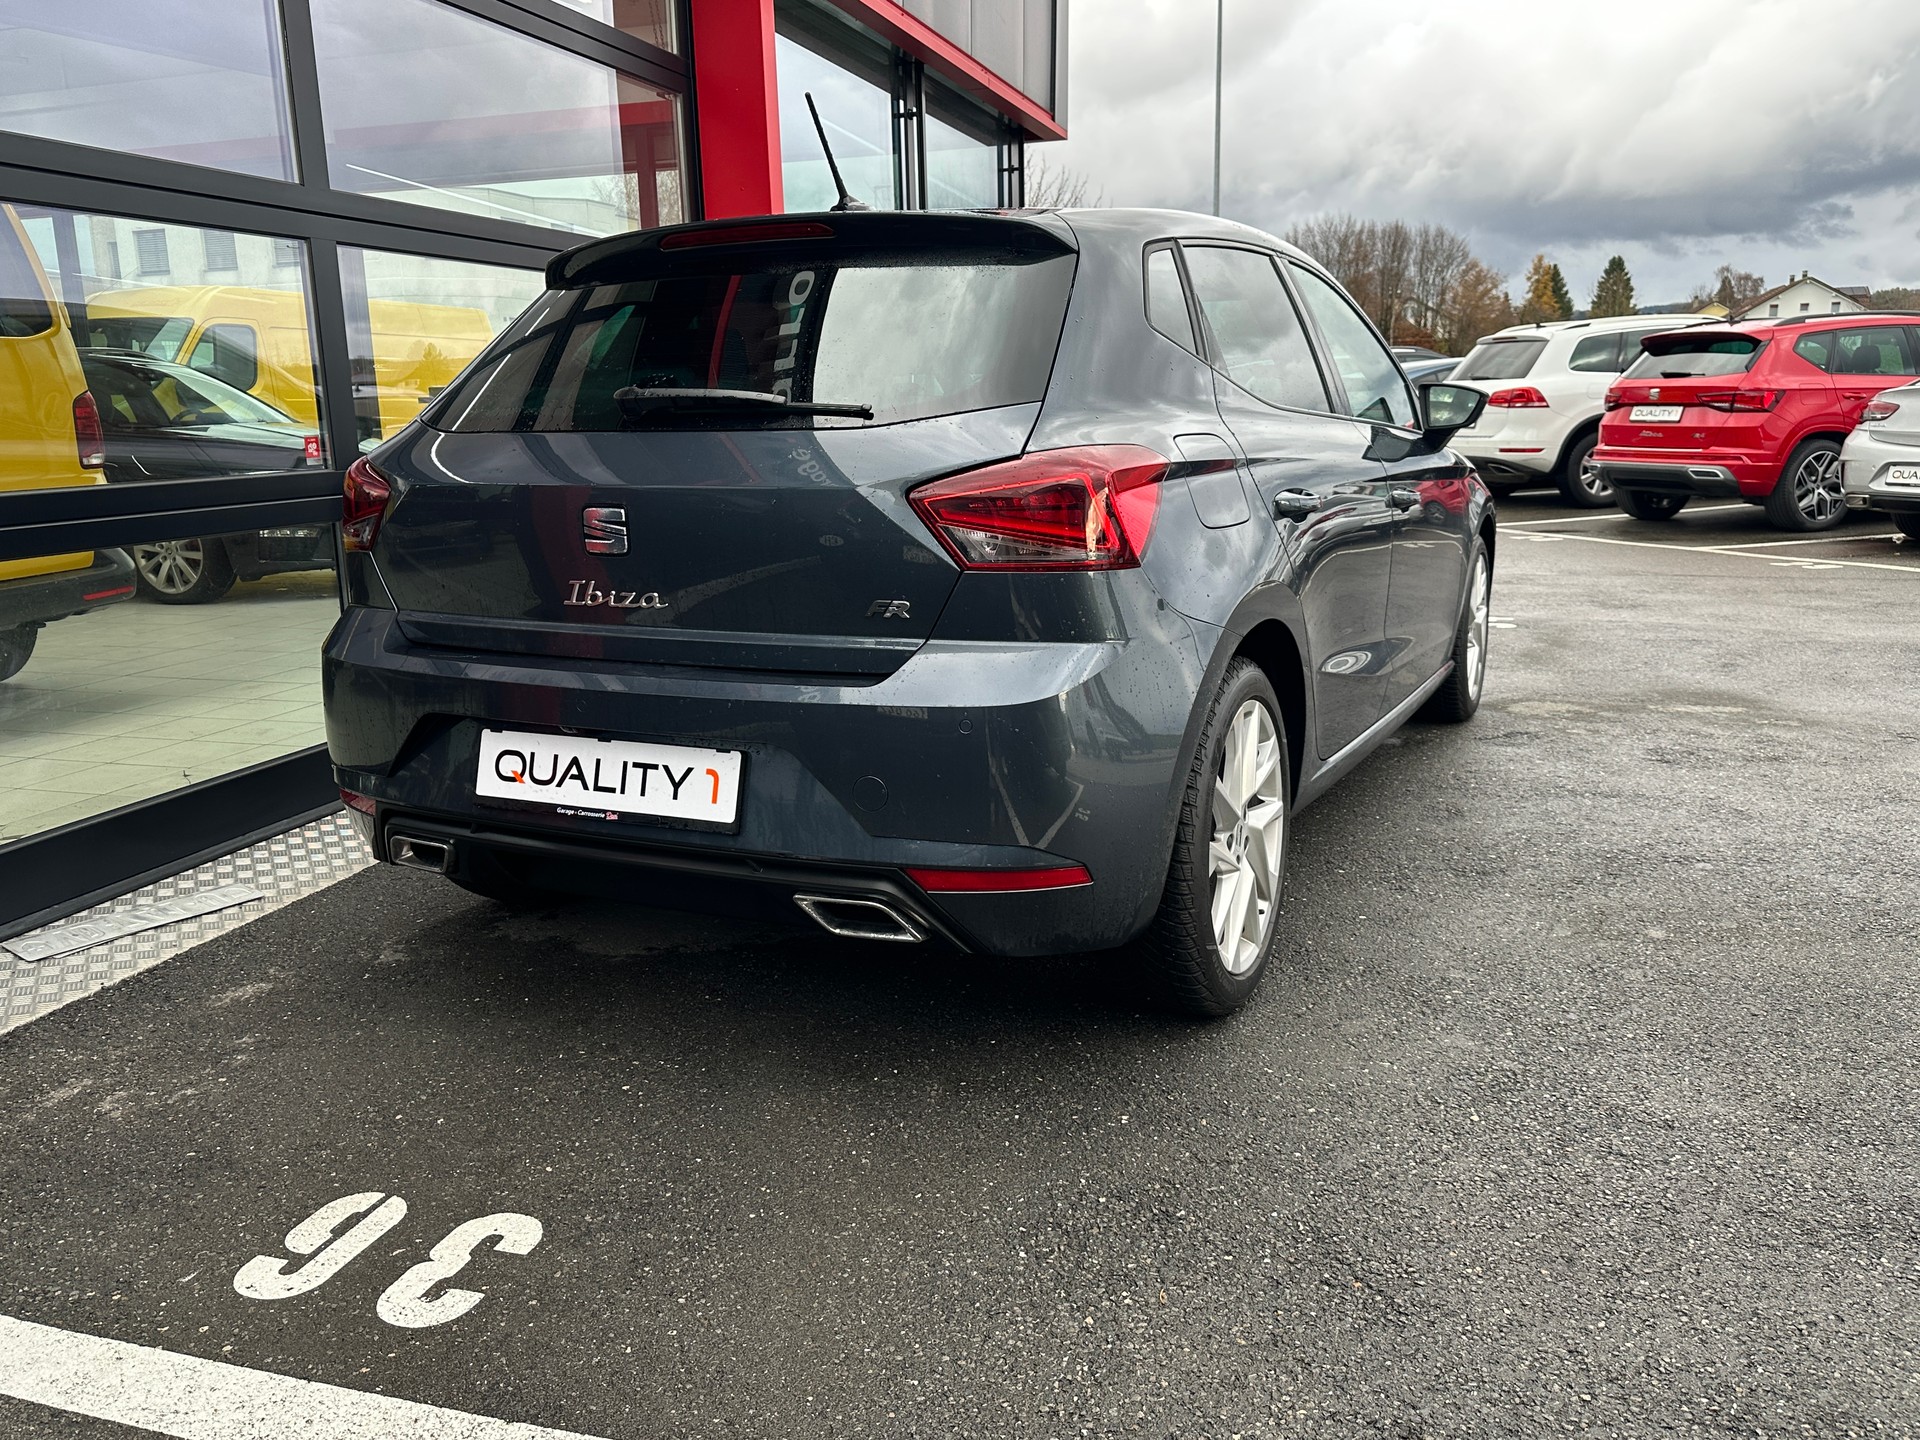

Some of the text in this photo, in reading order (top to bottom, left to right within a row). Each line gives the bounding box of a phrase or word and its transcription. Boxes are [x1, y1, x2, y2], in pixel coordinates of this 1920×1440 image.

[1634, 409, 1672, 417] QUALITY
[1892, 470, 1920, 480] QUA
[563, 579, 669, 609] Ibiza
[865, 599, 910, 618] FR
[494, 749, 720, 804] QUALITY 1
